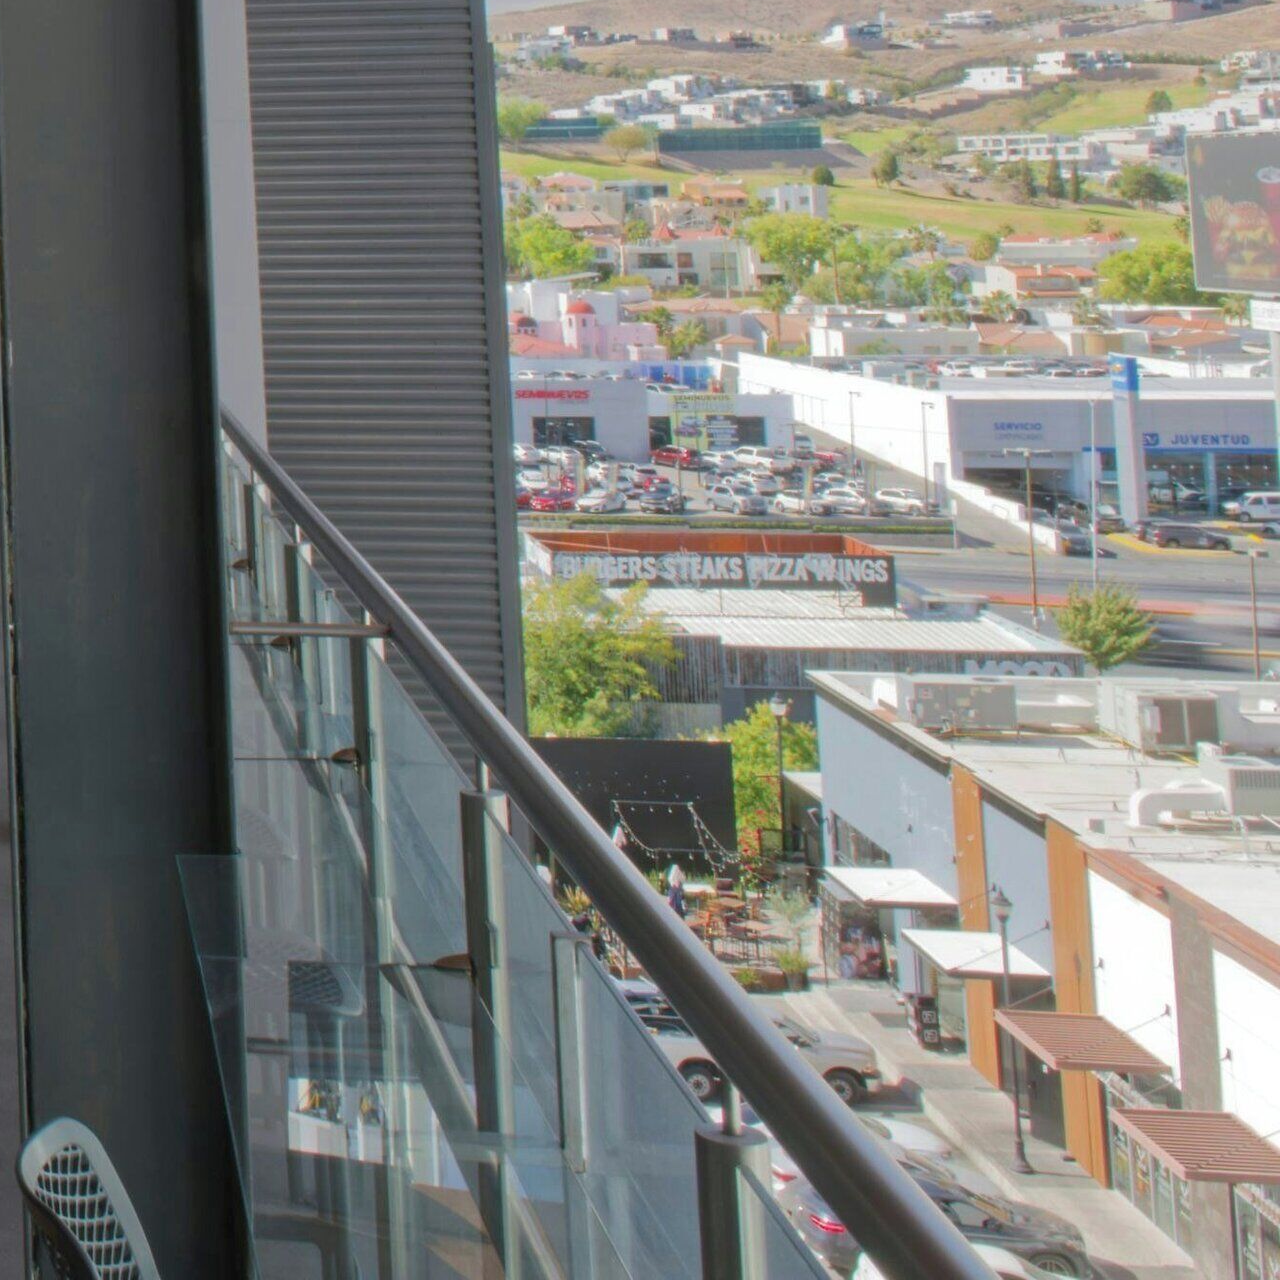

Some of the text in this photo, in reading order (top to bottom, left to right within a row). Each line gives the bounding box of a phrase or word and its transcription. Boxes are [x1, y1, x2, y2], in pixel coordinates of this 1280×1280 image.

[993, 422, 1042, 431] SERVICIO
[1171, 433, 1250, 445] JUVENTUD
[661, 556, 742, 582] STEAKS
[750, 556, 809, 581] PIZZA
[810, 557, 889, 583] WINGS
